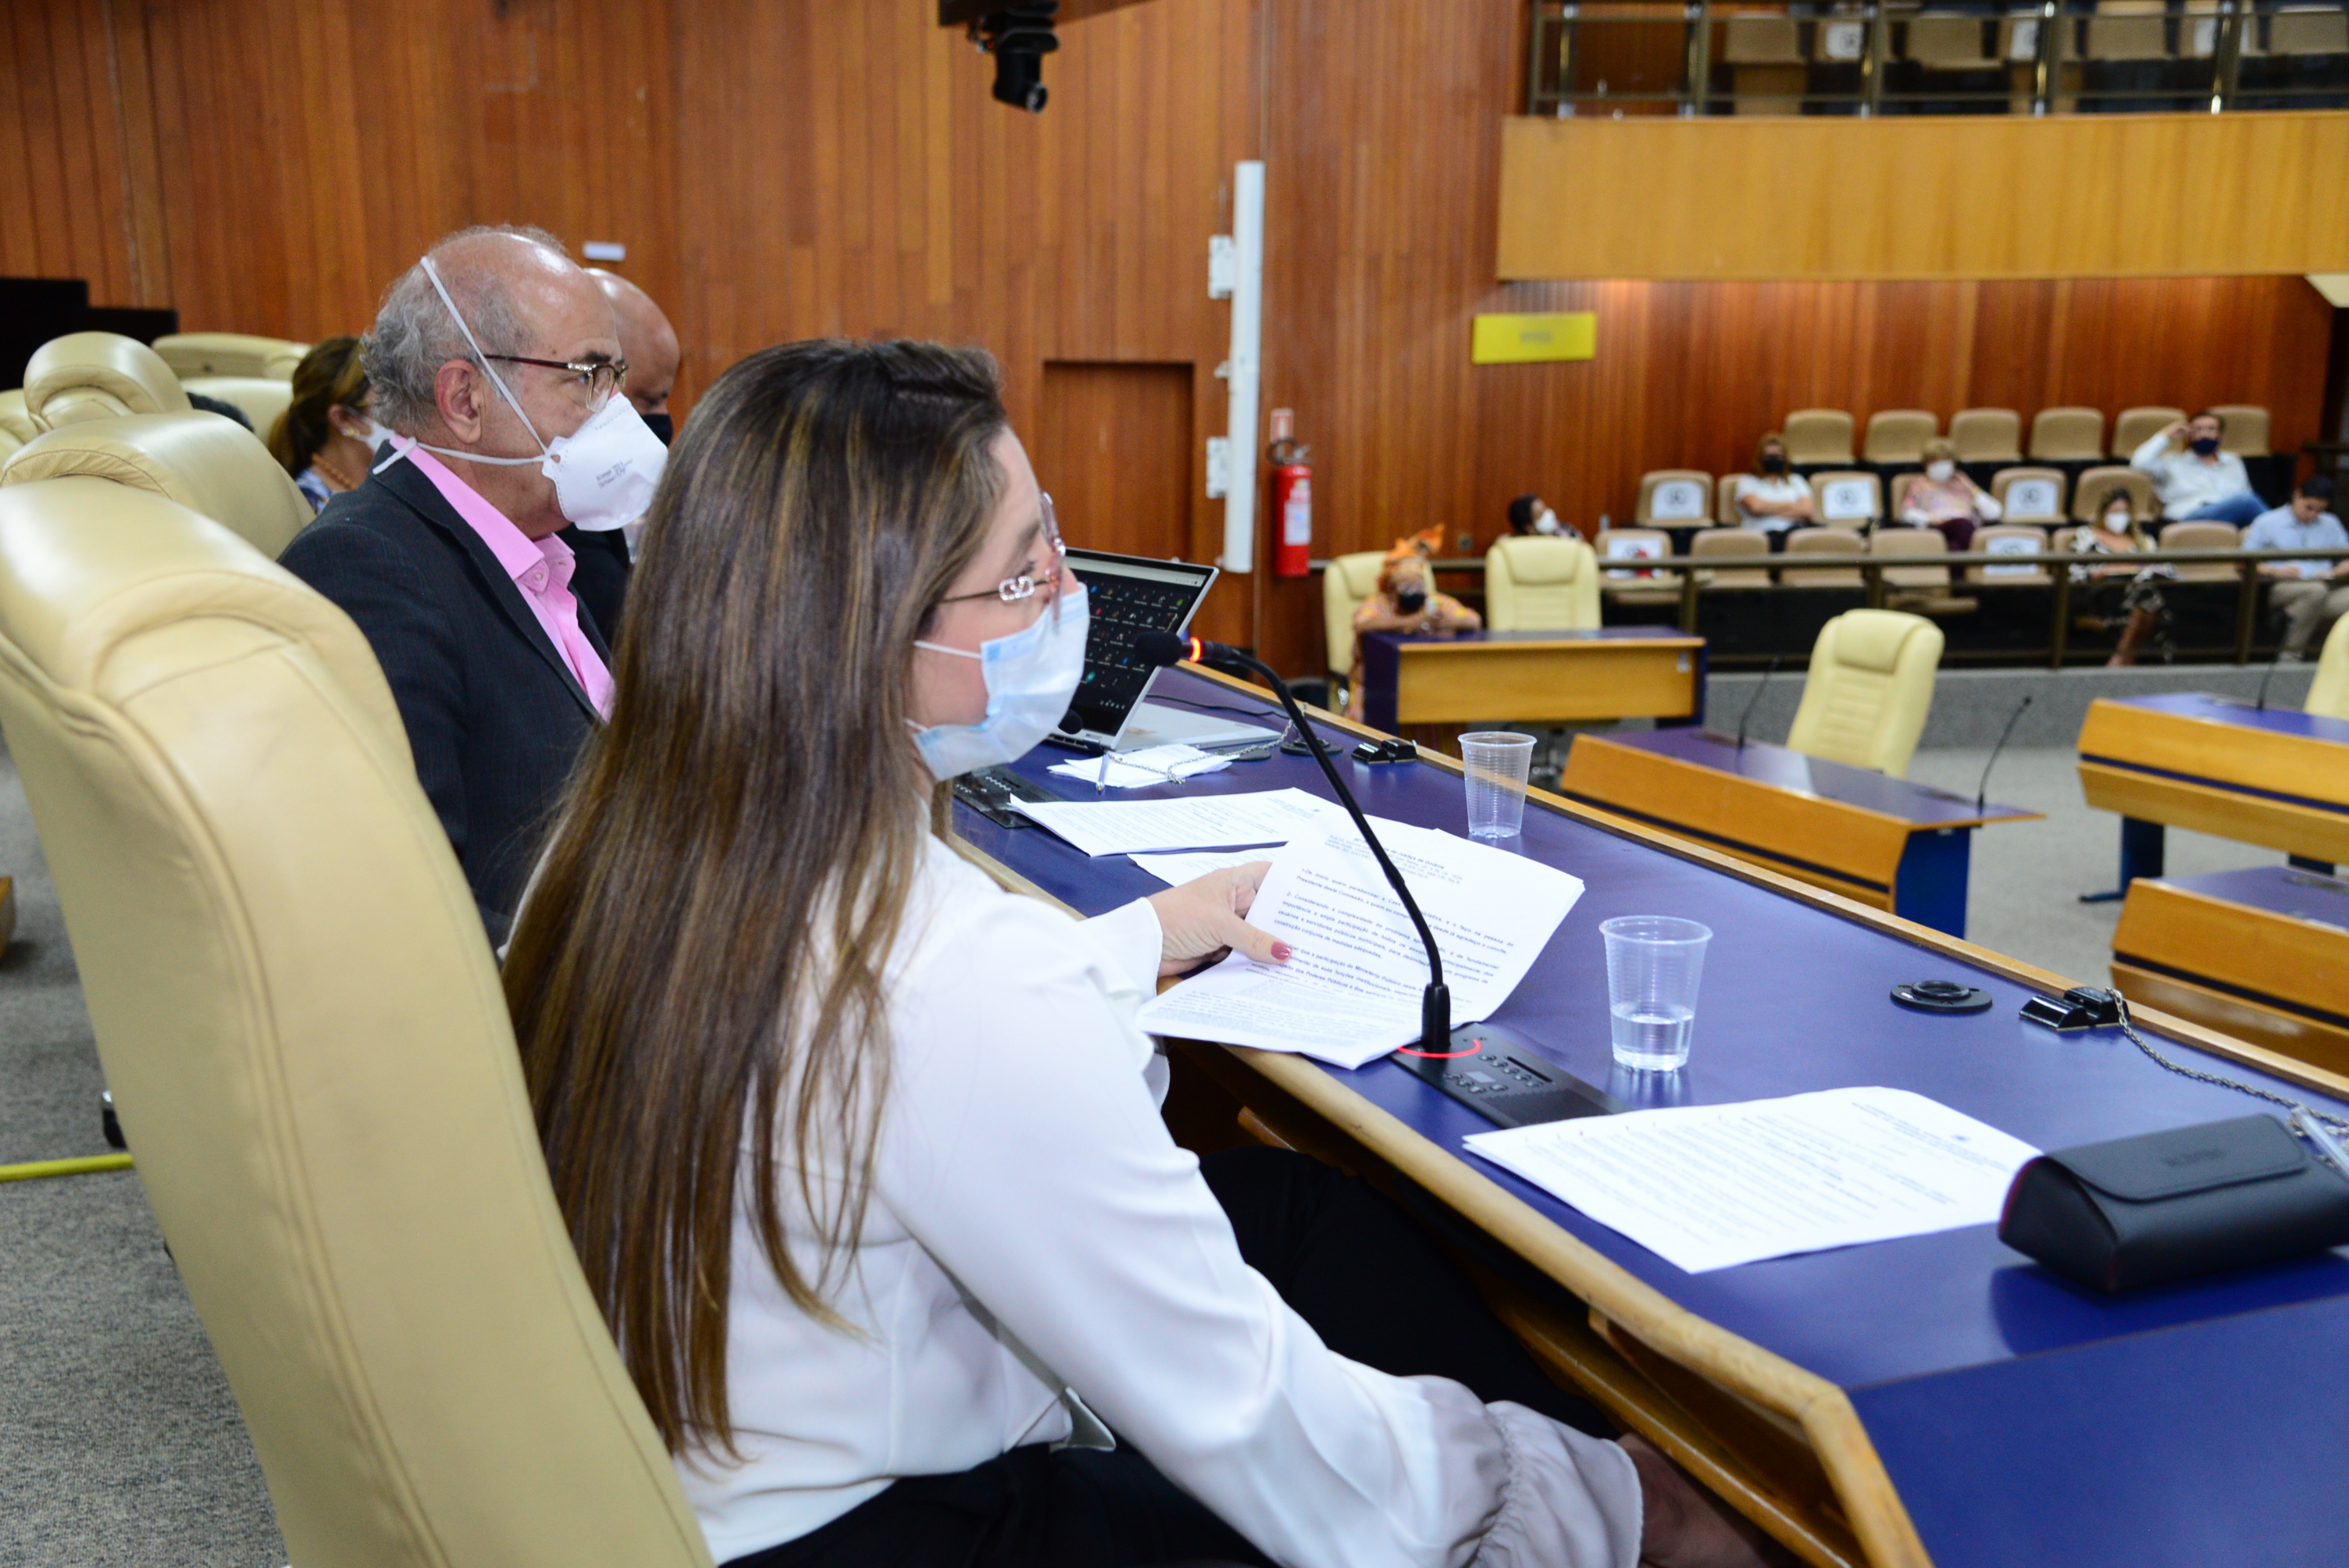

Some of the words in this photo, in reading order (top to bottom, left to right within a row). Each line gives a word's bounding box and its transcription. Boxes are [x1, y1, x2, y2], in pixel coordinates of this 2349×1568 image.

[1397, 852, 1416, 861] Justiça
[1424, 860, 1444, 869] Goiânia
[1282, 901, 1311, 913] importância
[1337, 920, 1368, 932] participação
[1381, 935, 1395, 943] todos
[1296, 875, 1322, 887] Presidente
[1456, 934, 1481, 945] agradeço
[1349, 886, 1378, 898] parabenizar
[1484, 935, 1503, 943] pessoa
[1274, 919, 1300, 930] construção
[1301, 928, 1323, 939] conjunta
[1331, 939, 1353, 948] medidas
[1353, 946, 1381, 958] adequadas.
[1278, 911, 1299, 919] usuários
[1306, 919, 1332, 931] servidores
[1334, 929, 1356, 939] públicos
[1358, 937, 1385, 950] municipais,
[1454, 972, 1479, 981] programa
[1294, 895, 1328, 909] Considerando
[1338, 911, 1372, 924] complexidade
[1385, 927, 1410, 939] problema
[1467, 957, 1499, 969] fundamental
[1306, 971, 1325, 981] Poderes
[1327, 977, 1348, 987] Públicos
[1315, 954, 1346, 966] participação
[1355, 965, 1380, 978] Ministério
[1381, 976, 1401, 985] Público
[1335, 970, 1353, 978] funções
